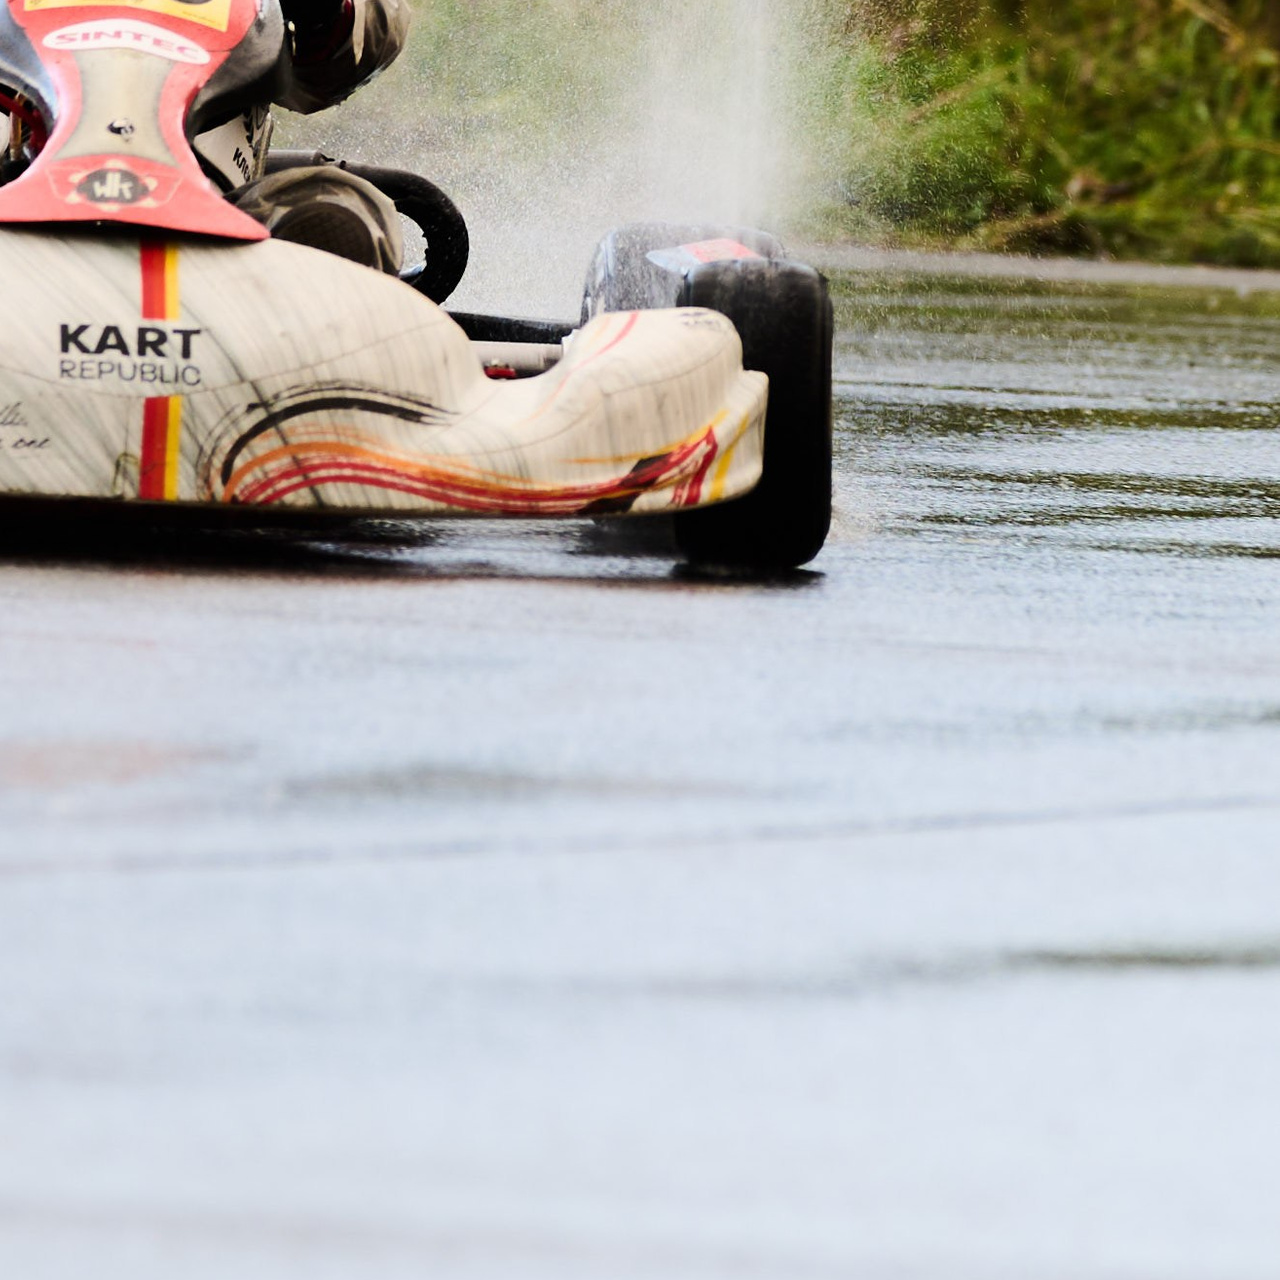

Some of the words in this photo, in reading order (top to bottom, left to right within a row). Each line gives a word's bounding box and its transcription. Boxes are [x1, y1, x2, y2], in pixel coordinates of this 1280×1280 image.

[54, 30, 200, 61] SINTEC
[60, 324, 202, 360] KART
[60, 360, 202, 386] REPUBLIC
[11, 437, 50, 450] one
